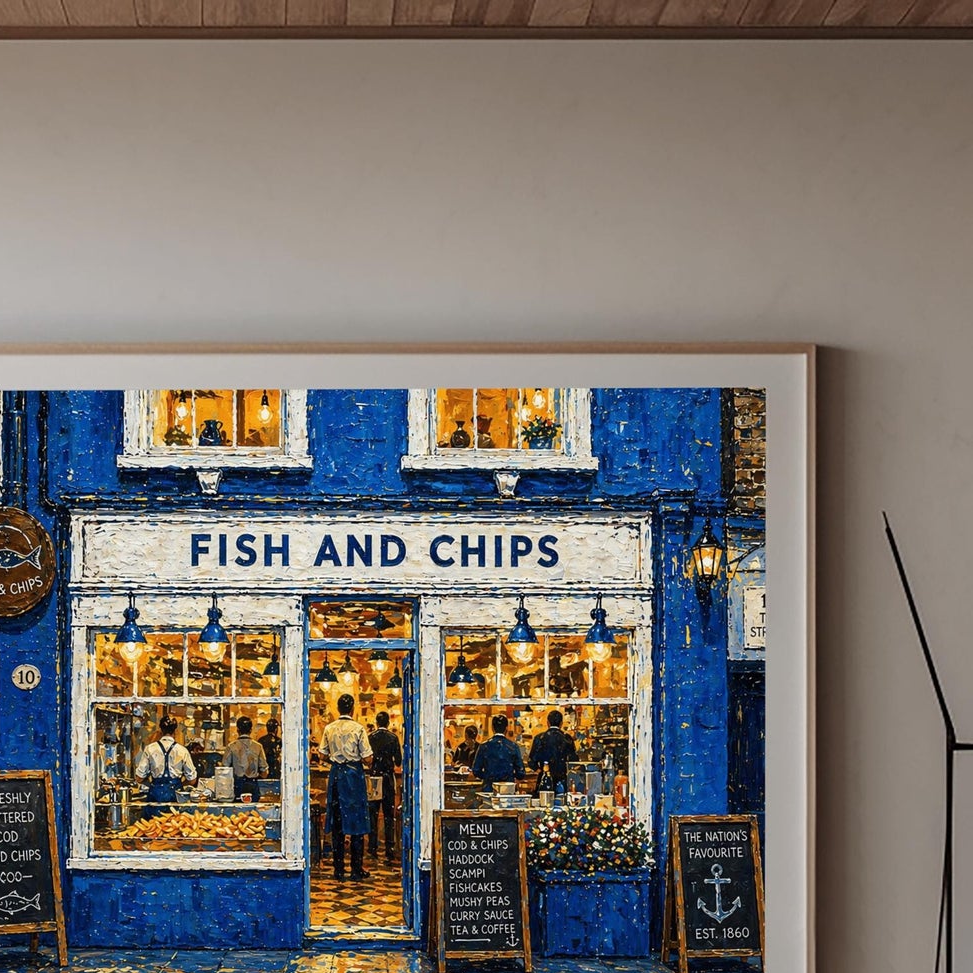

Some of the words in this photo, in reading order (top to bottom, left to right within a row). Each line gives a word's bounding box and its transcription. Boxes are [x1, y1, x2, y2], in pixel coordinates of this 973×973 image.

[190, 533, 289, 567] FISH
[313, 533, 407, 567] AND
[429, 533, 559, 568] CHIPS
[9, 575, 44, 595] CHIPS
[18, 670, 35, 684] 10
[459, 823, 493, 835] MENU
[683, 831, 702, 842] THE
[705, 829, 748, 842] NATION'S
[447, 840, 468, 851] COD
[470, 840, 478, 850] &
[480, 839, 509, 850] CHIPS
[10, 849, 42, 862] CHIPS
[689, 847, 744, 859] FAVOURITE
[448, 854, 495, 865] HADDOCK
[449, 868, 486, 879] SCAMPI
[449, 882, 503, 893] FISHCAKES
[449, 897, 483, 907] MUSHY
[486, 896, 511, 906] PEAS
[449, 911, 480, 922] CURRY
[484, 909, 514, 920] SAUCE
[450, 925, 469, 935] TEA
[471, 925, 479, 935] &
[481, 923, 516, 934] COFFEE
[695, 928, 718, 940] EST.
[722, 927, 750, 939] 1860
